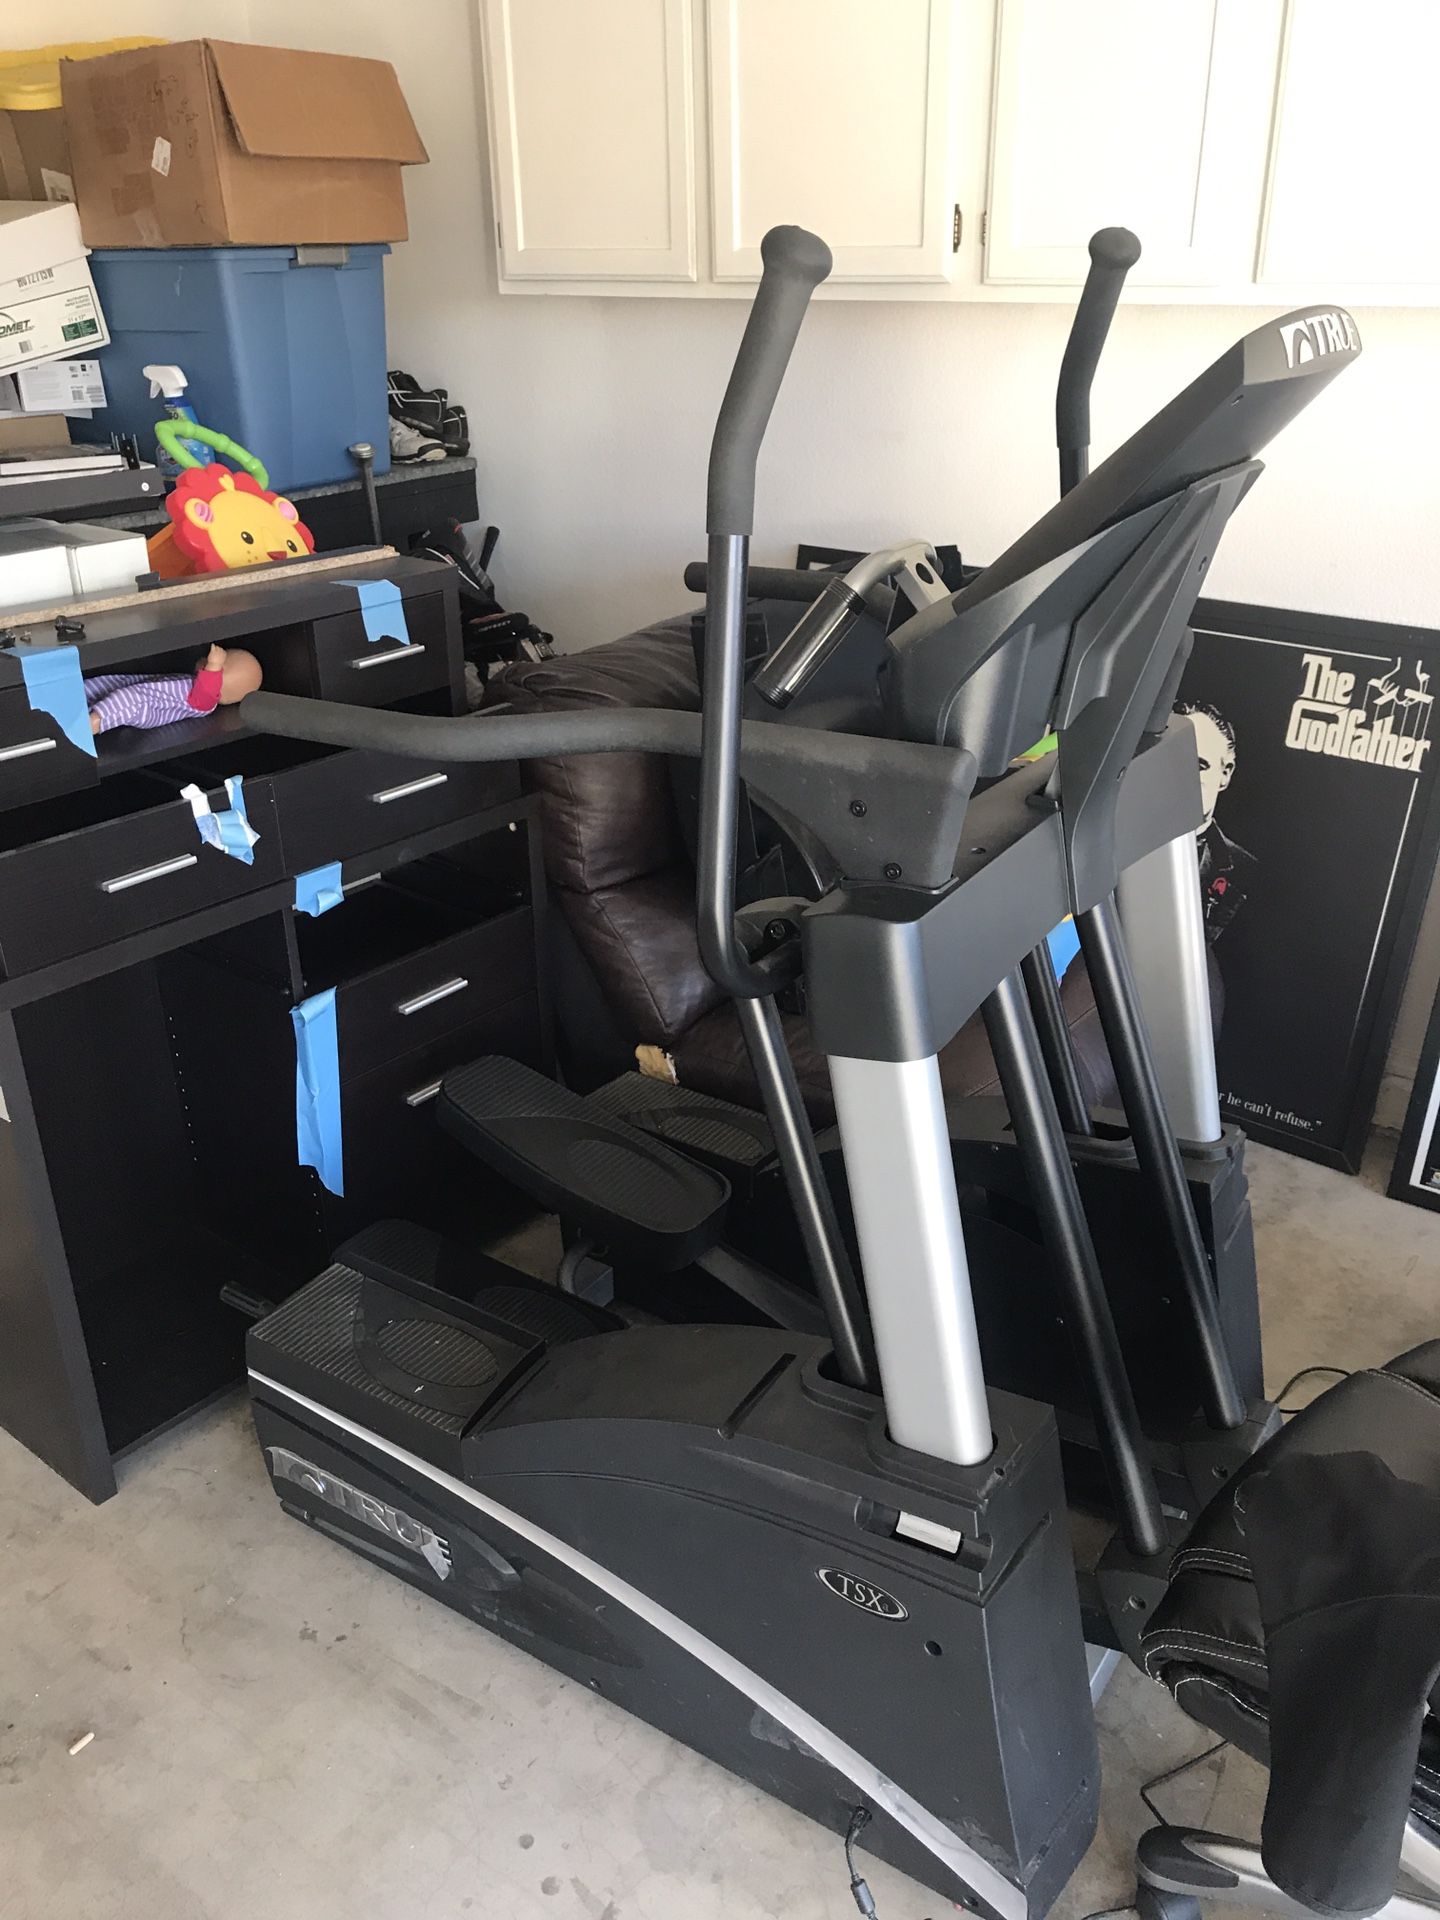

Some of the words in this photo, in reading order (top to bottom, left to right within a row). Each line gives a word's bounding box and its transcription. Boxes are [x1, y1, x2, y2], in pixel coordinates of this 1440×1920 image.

[1305, 312, 1358, 356] TRUE
[1298, 653, 1356, 705] The
[1284, 698, 1432, 773] Godfather
[1227, 1091, 1242, 1106] he
[1244, 1101, 1272, 1117] can't
[319, 1469, 453, 1567] TRUE
